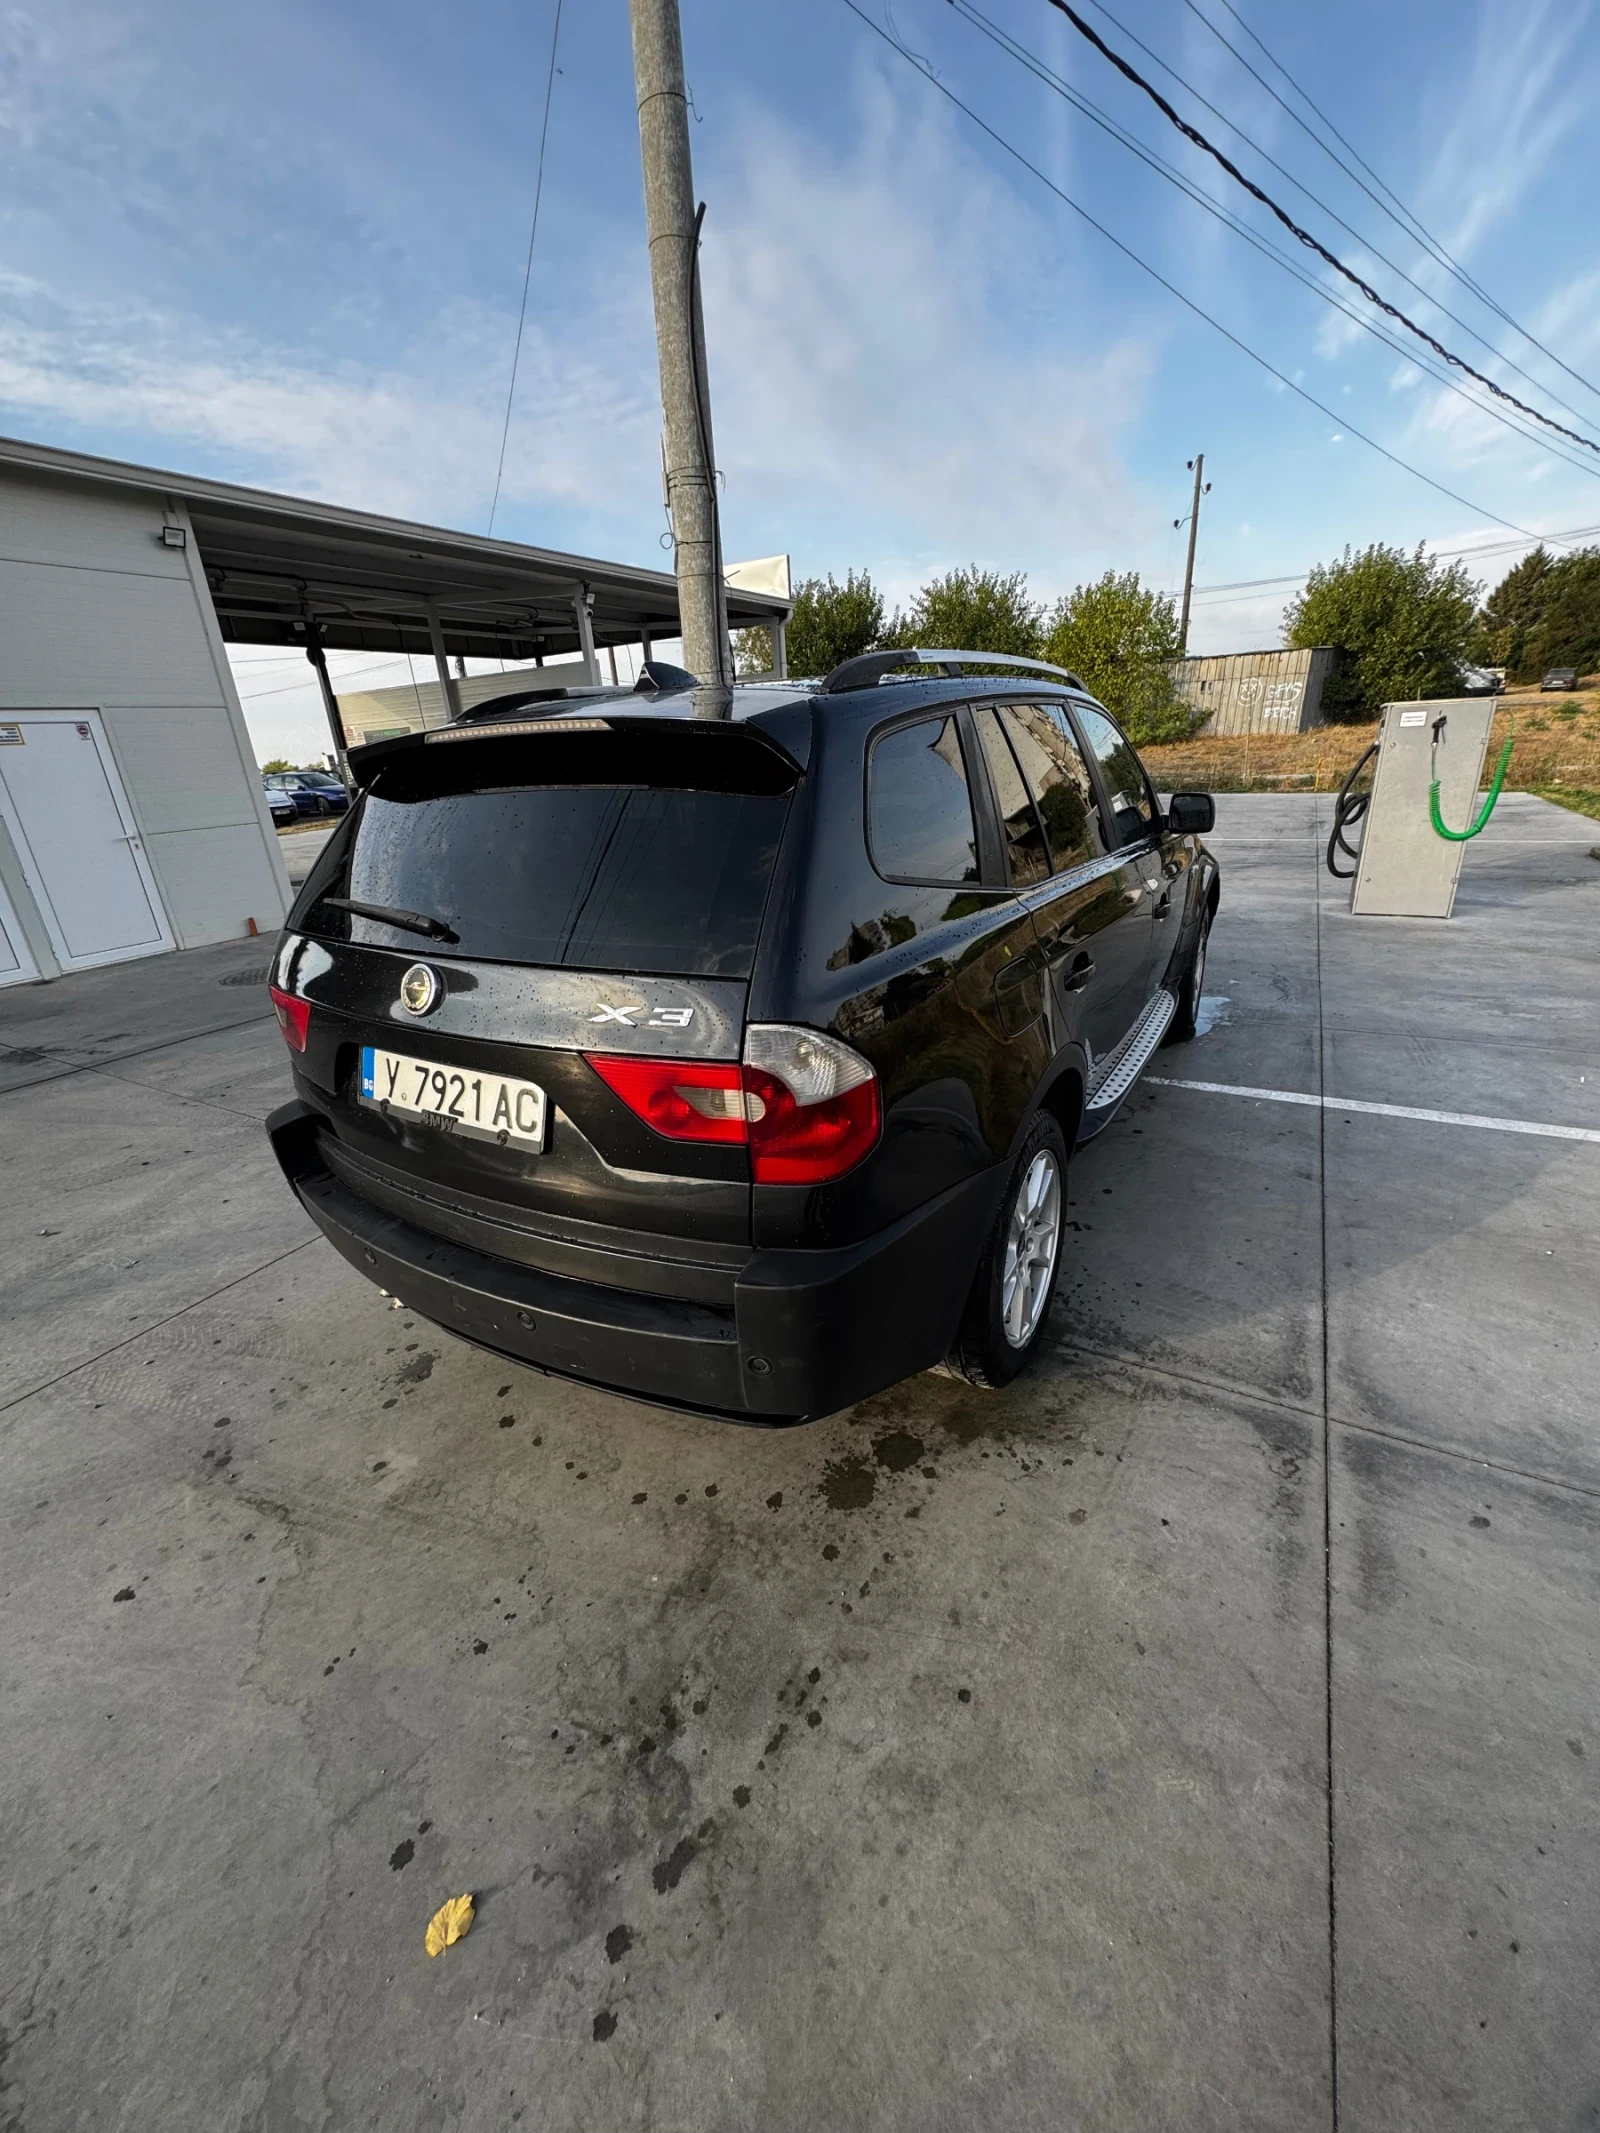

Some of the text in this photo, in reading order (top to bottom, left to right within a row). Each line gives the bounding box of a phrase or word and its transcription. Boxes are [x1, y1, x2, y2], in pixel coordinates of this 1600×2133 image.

[364, 1077, 374, 1091] BG
[414, 1065, 482, 1122] 7921
[421, 1112, 455, 1131] BMW
